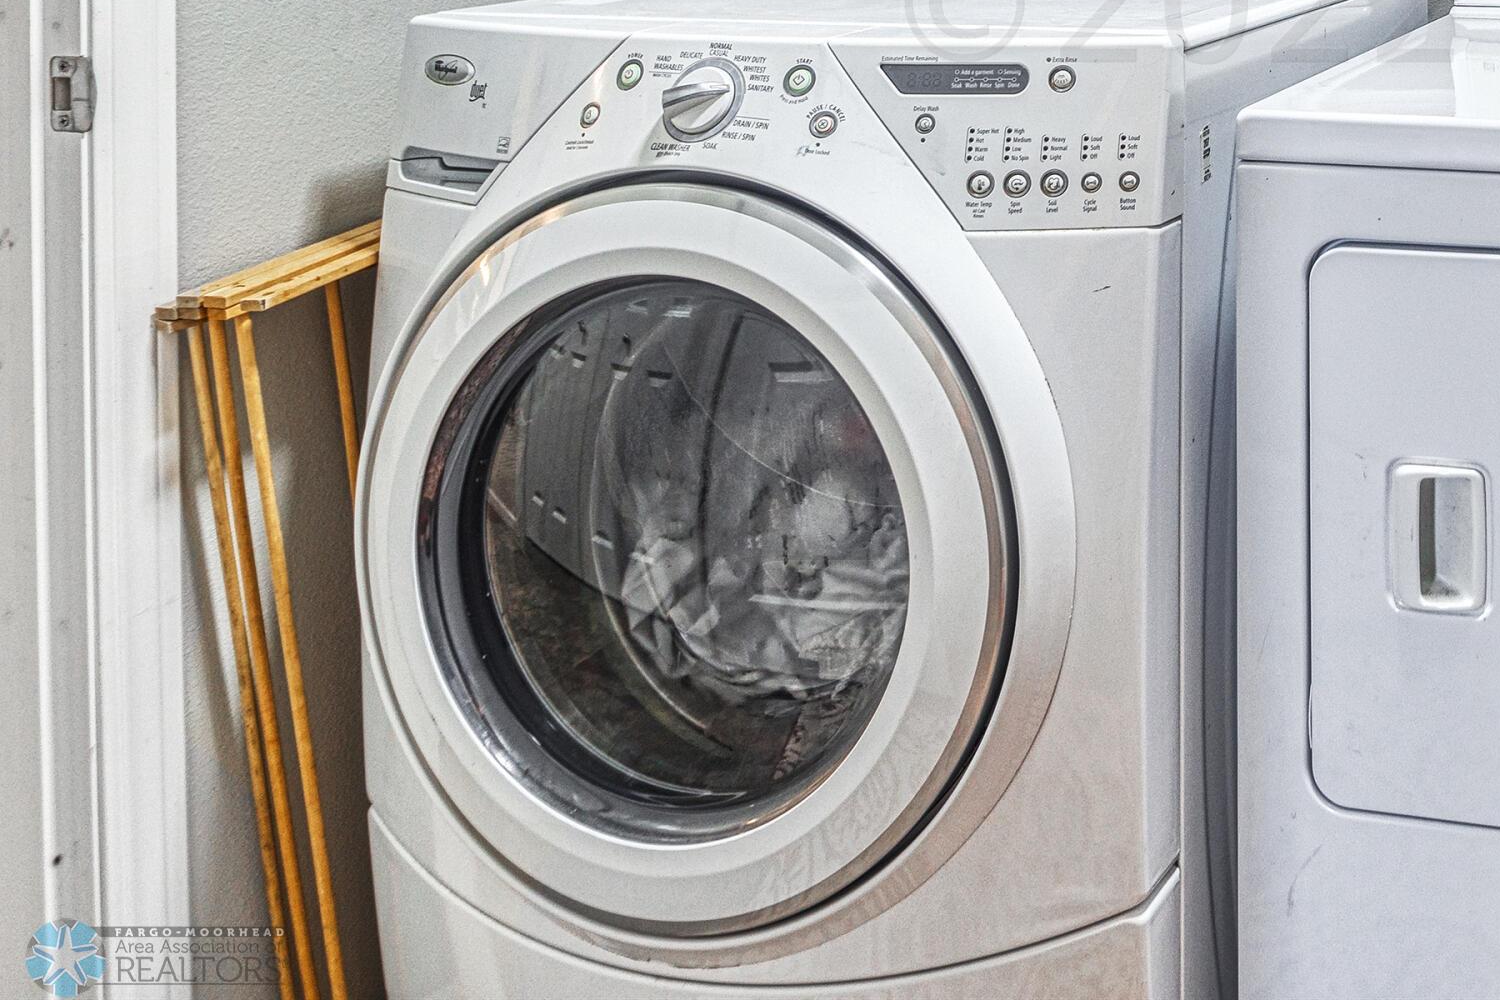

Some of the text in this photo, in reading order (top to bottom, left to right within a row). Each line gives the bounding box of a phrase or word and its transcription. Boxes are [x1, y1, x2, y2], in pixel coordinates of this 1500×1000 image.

[709, 42, 733, 50] NORMAL
[679, 51, 703, 59] DELICATE
[751, 56, 767, 64] DUTY
[653, 63, 684, 71] WASHABLES
[749, 74, 770, 82] WHITES
[747, 84, 774, 92] SANITARY
[806, 104, 823, 119] PAUSE
[829, 104, 846, 122] CANCEL
[733, 120, 751, 128] DRAIN
[756, 121, 769, 130] SPIN
[722, 131, 737, 139] RINSE
[742, 133, 755, 141] SPIN
[651, 142, 691, 151] CLEAN WASHER
[702, 142, 718, 150] SOAK
[1007, 207, 1023, 215] Speed
[1083, 205, 1097, 213] Signal
